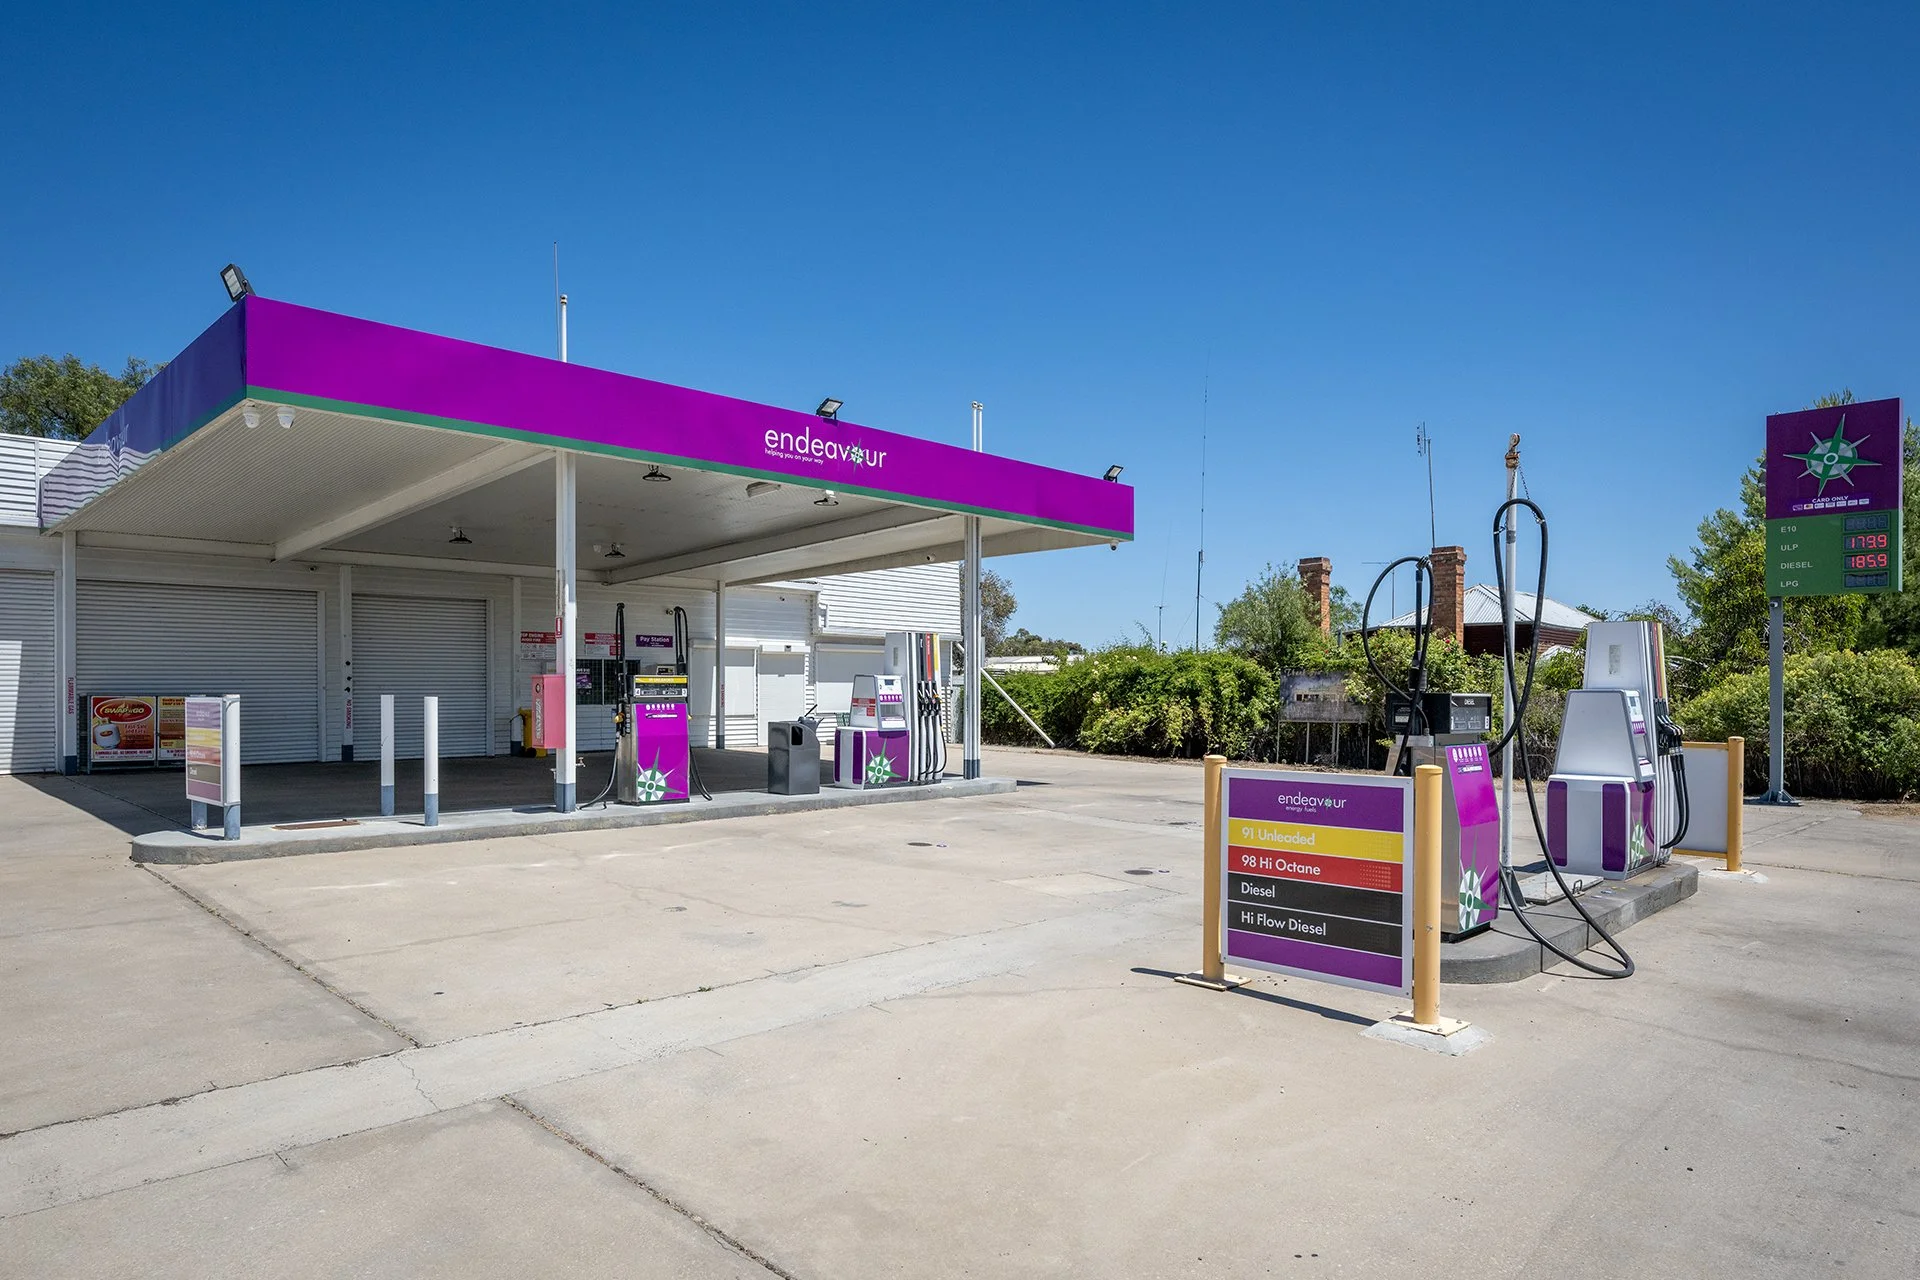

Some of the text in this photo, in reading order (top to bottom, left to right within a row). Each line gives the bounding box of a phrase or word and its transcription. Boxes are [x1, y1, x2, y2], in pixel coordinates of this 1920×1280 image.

[764, 426, 887, 468] endeavour
[765, 447, 784, 458] helping
[1780, 525, 1797, 533] E10
[1780, 543, 1799, 551] ULP
[1780, 561, 1813, 569] DIESEL
[1780, 580, 1799, 588] LPG
[1278, 791, 1347, 809] endeavour
[1241, 826, 1315, 846] 91 Unleaded
[1241, 854, 1321, 876] 98 Hi Octane
[1241, 881, 1276, 898] Diesel
[1241, 911, 1327, 936] Hi Flow Diesel
